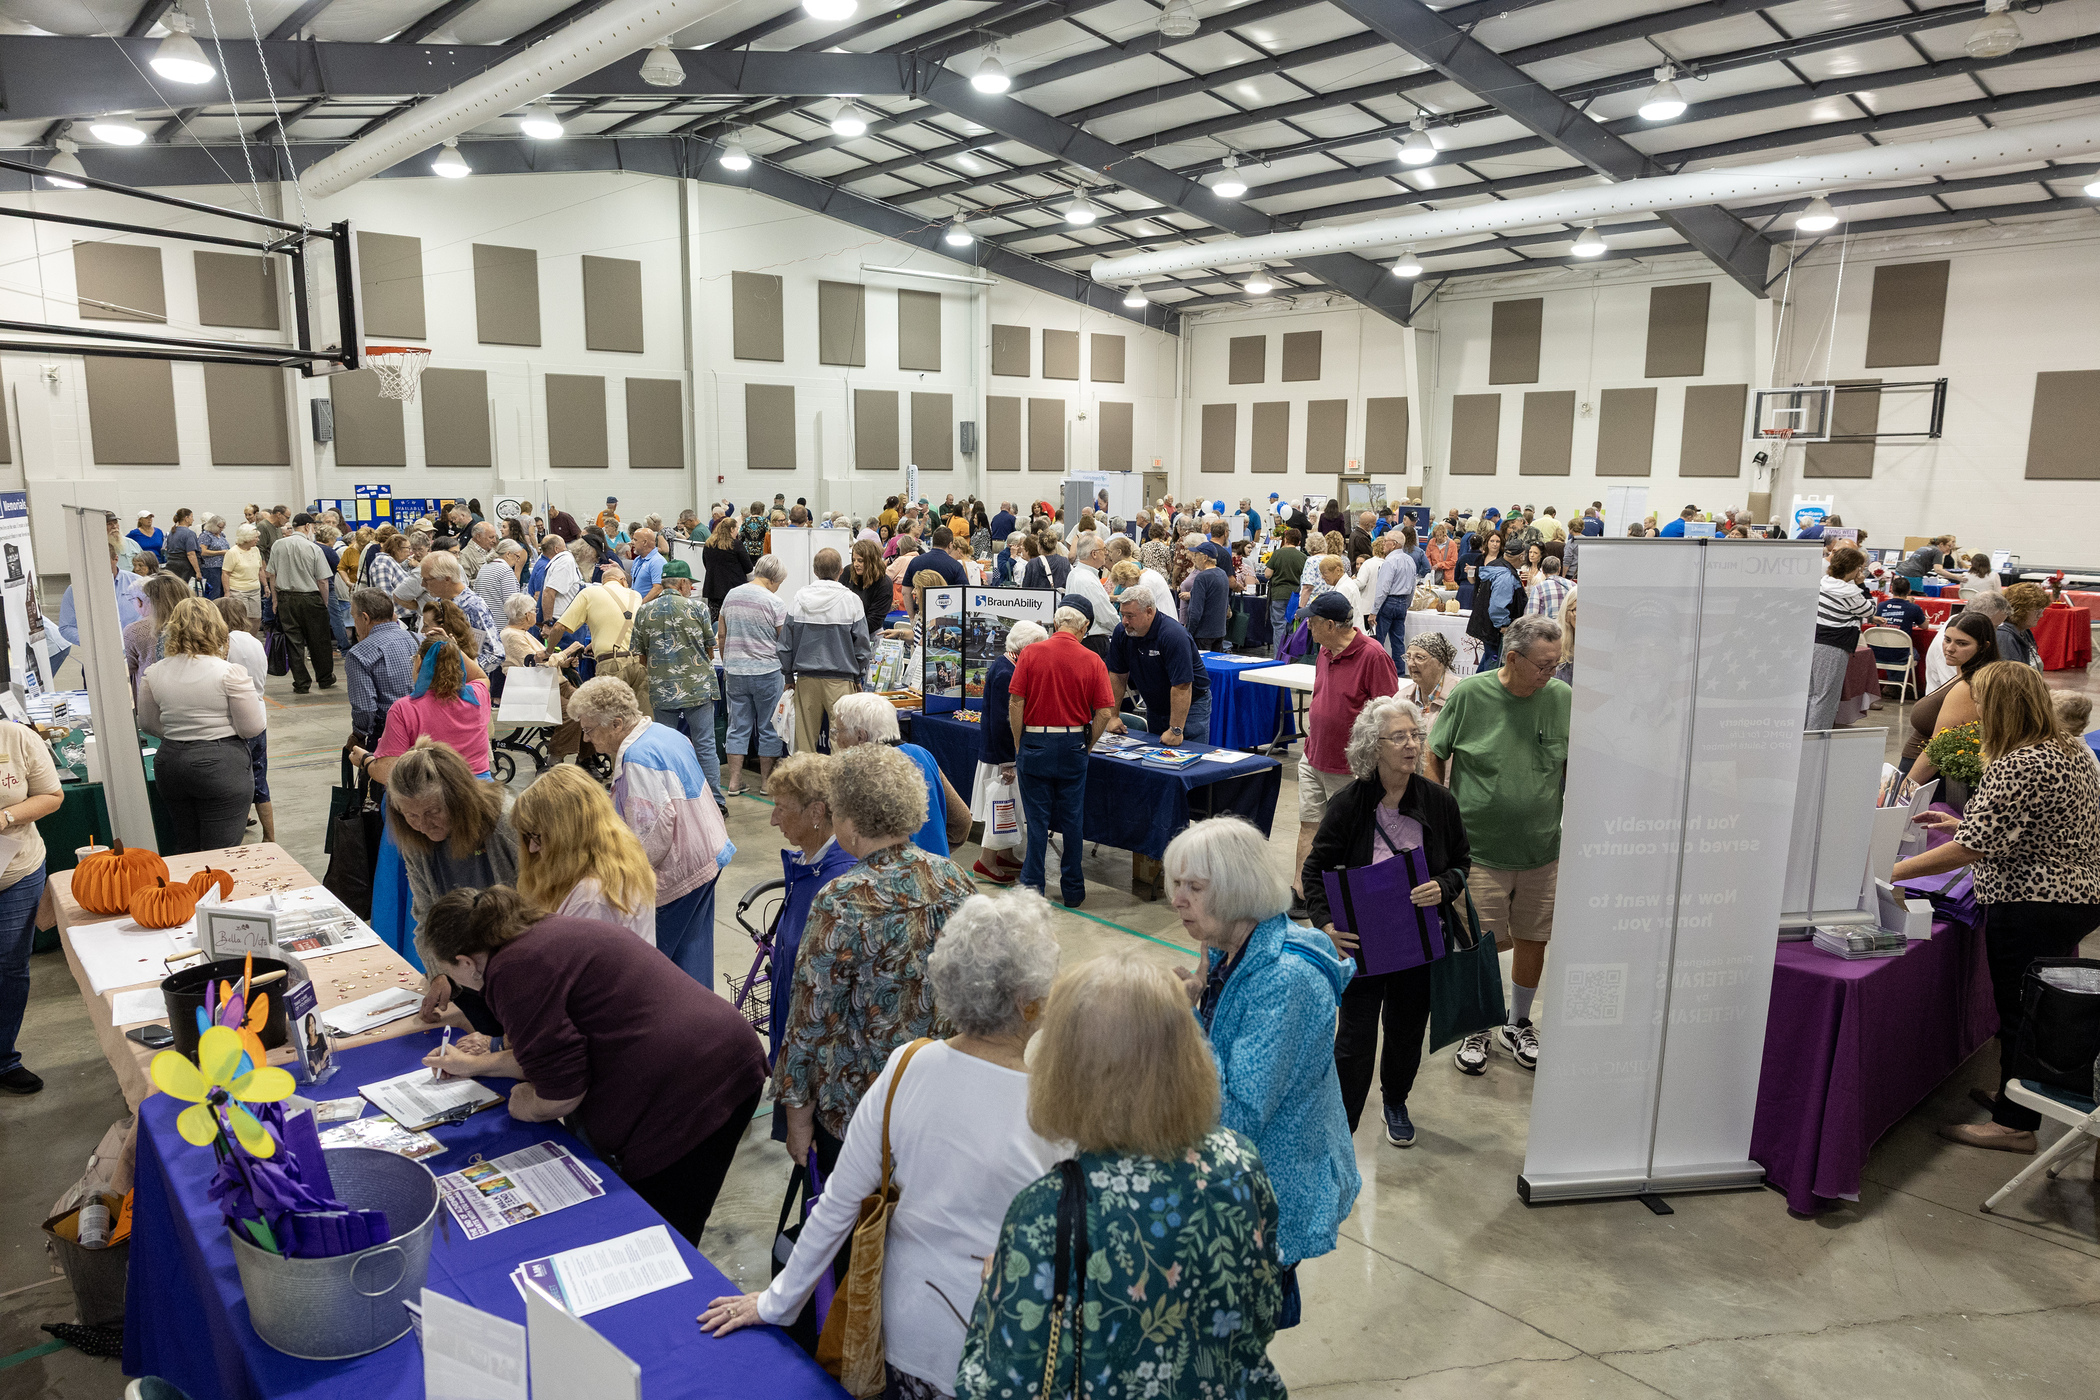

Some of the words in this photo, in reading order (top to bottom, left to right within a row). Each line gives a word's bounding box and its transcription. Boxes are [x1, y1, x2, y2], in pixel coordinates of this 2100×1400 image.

[2, 499, 27, 512] Memorials
[987, 596, 1043, 610] BraunAbility
[0, 771, 20, 789] ita
[215, 930, 242, 947] Bella
[244, 932, 268, 949] Vita
[491, 1195, 507, 1209] WALK
[499, 1192, 512, 1203] END
[465, 1210, 477, 1220] WITH
[463, 1219, 474, 1228] END
[471, 1219, 486, 1233] STARTS
[468, 1227, 479, 1236] THE
